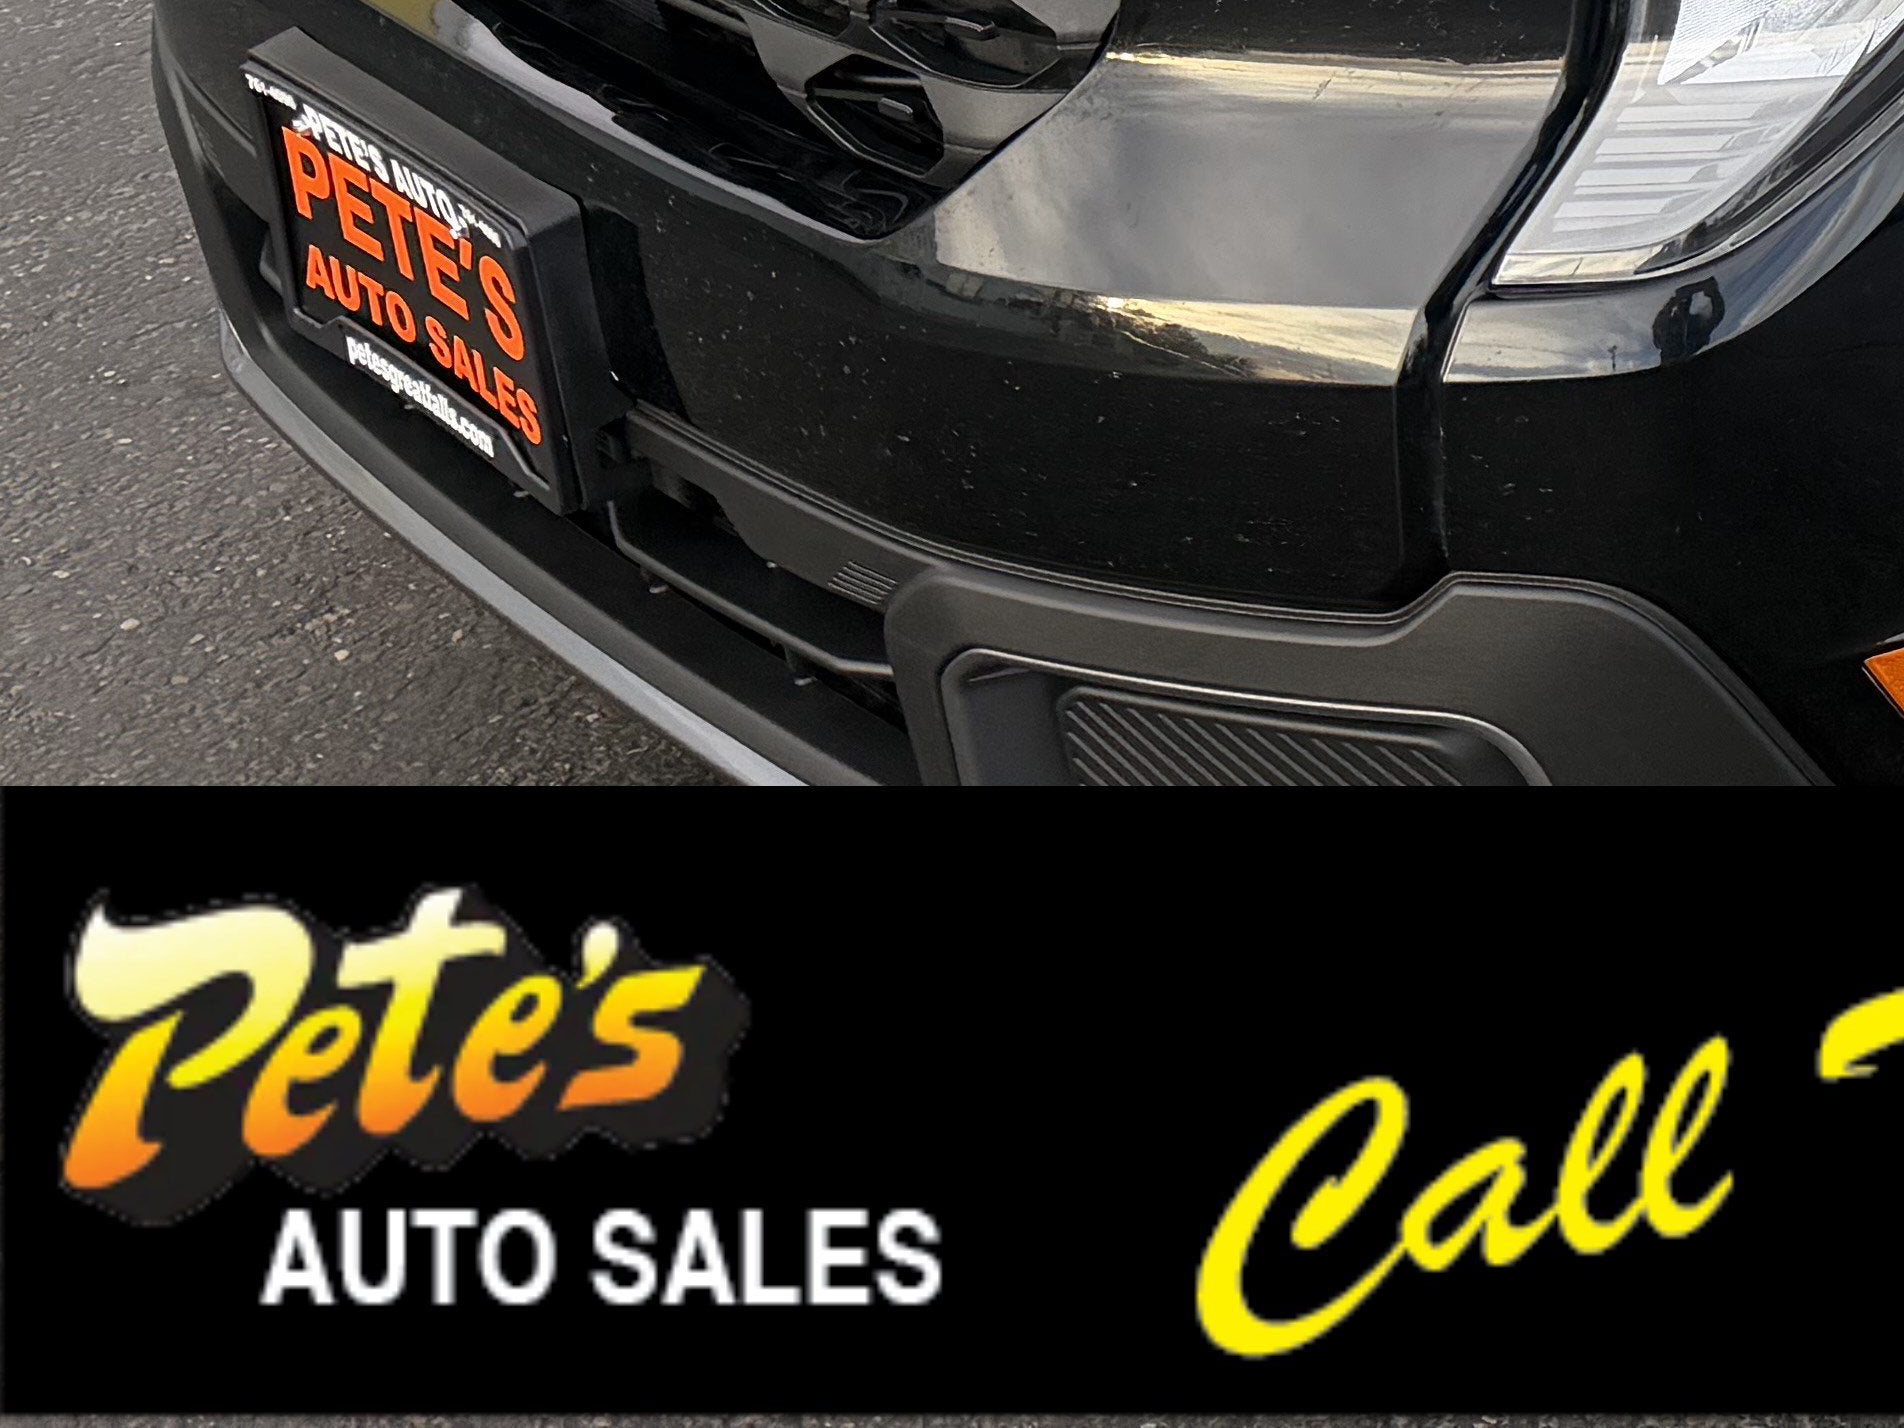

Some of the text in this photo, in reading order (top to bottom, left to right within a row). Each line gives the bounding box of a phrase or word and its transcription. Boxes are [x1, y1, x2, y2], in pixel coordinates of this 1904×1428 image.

[281, 125, 525, 361] PETE'S
[303, 104, 391, 185] PETE'S
[391, 159, 461, 231] AUTO
[305, 244, 543, 445] AUTO SALES
